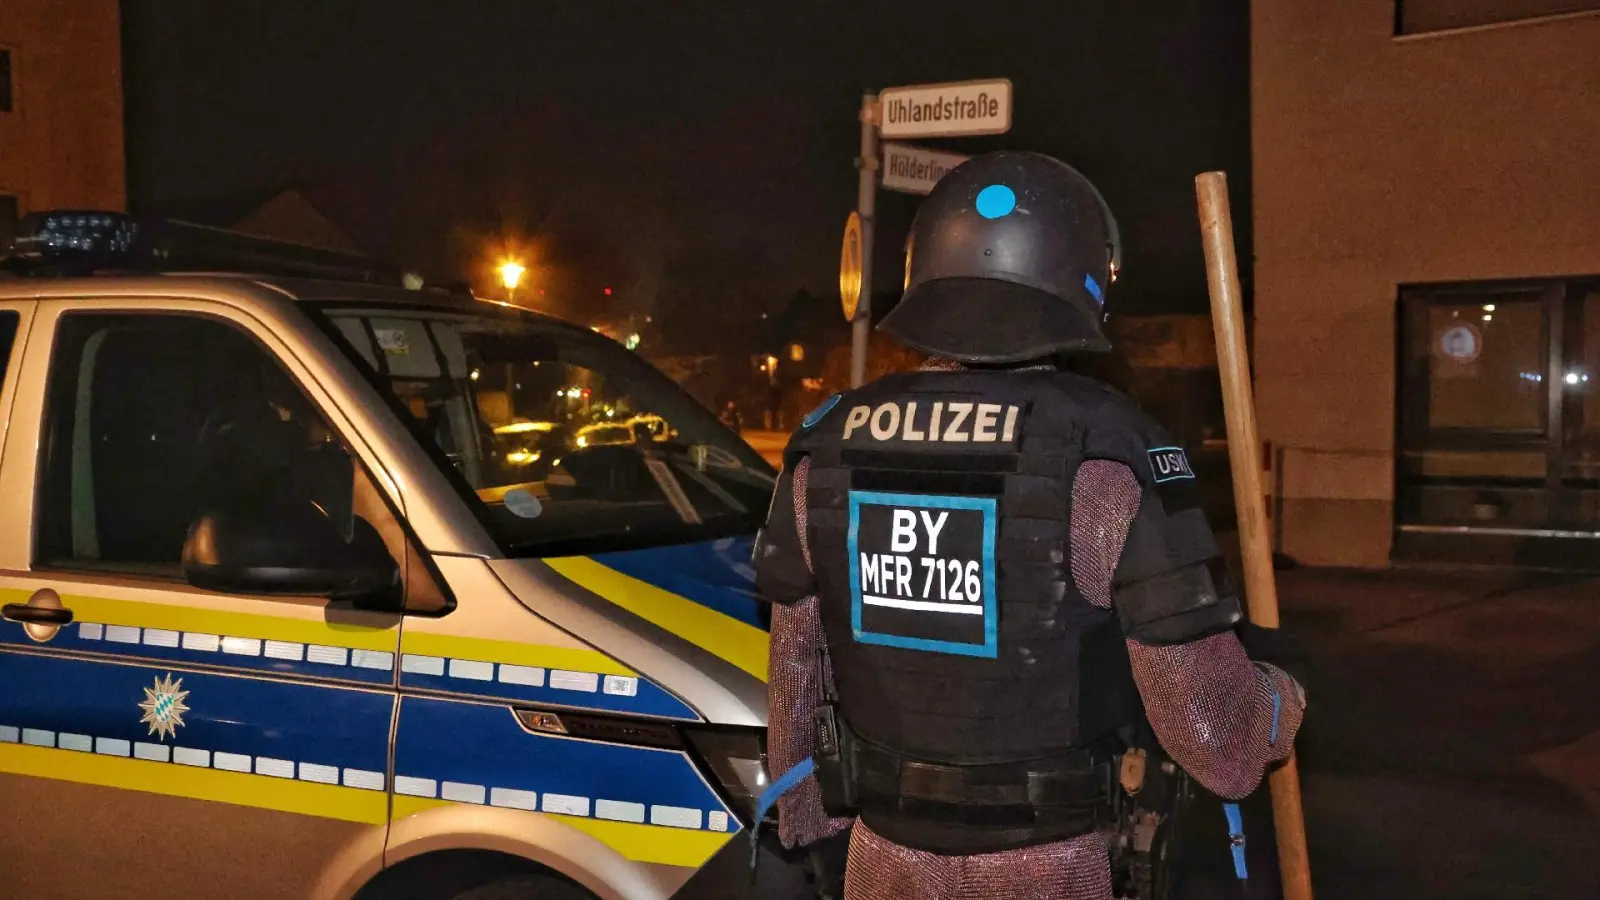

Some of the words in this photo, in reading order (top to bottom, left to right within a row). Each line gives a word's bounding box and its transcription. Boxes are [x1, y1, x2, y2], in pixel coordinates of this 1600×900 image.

[888, 93, 999, 124] Uhlandstraße
[842, 402, 1019, 442] POLIZEI
[891, 509, 949, 555] BY
[860, 552, 913, 597] MFR
[921, 557, 981, 602] 7126
